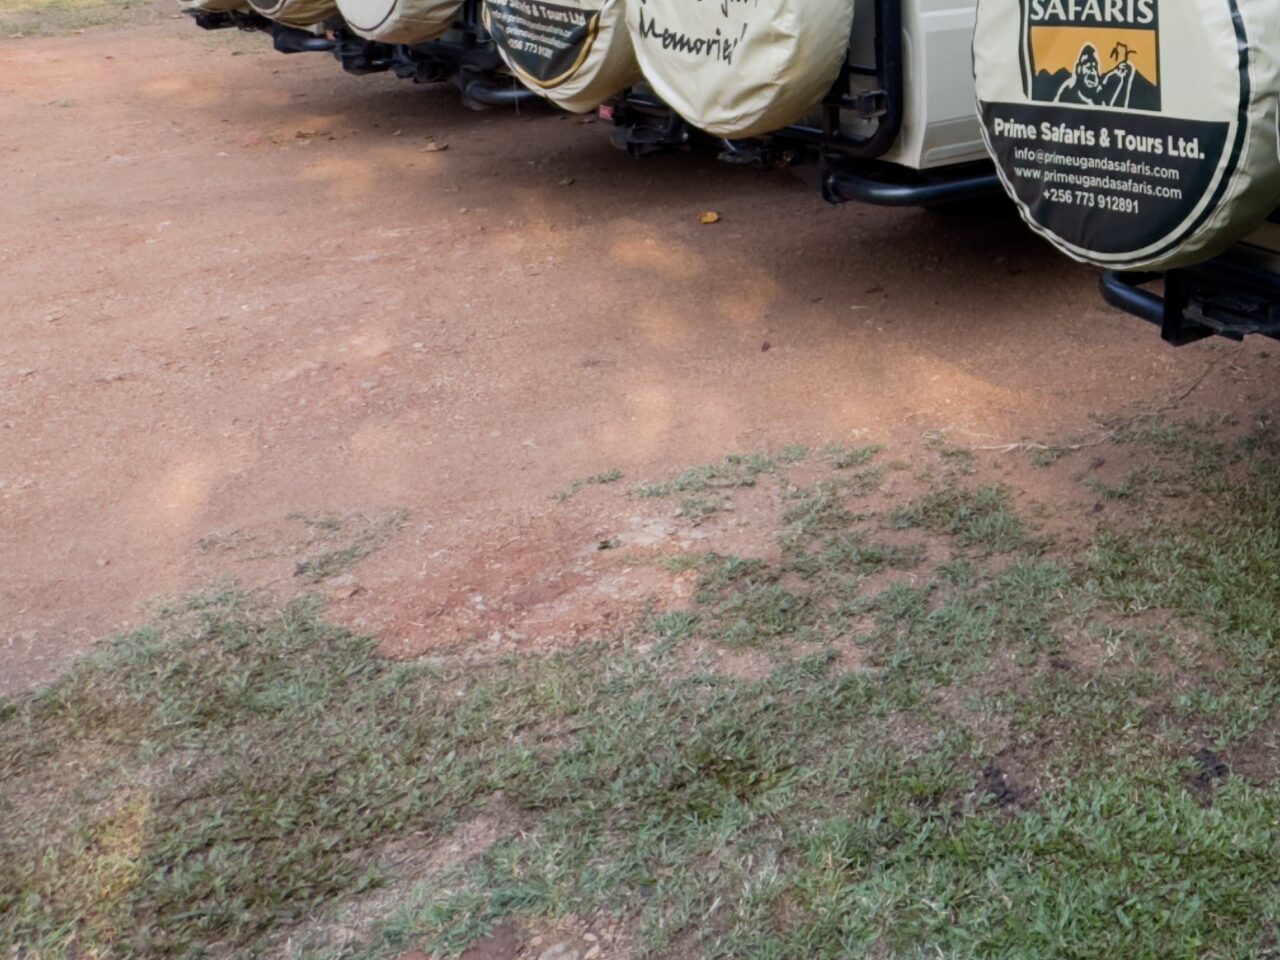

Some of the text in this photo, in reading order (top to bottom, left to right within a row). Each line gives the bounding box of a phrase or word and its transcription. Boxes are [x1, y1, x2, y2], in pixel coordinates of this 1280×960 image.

[993, 117, 1206, 160] Prime Safaris & Tours Ltd.
[1013, 146, 1180, 181] info@primeugandasafaris.com
[1013, 166, 1183, 200] www.primeugandasafaris.com
[1042, 188, 1140, 215] +256 773 912891
